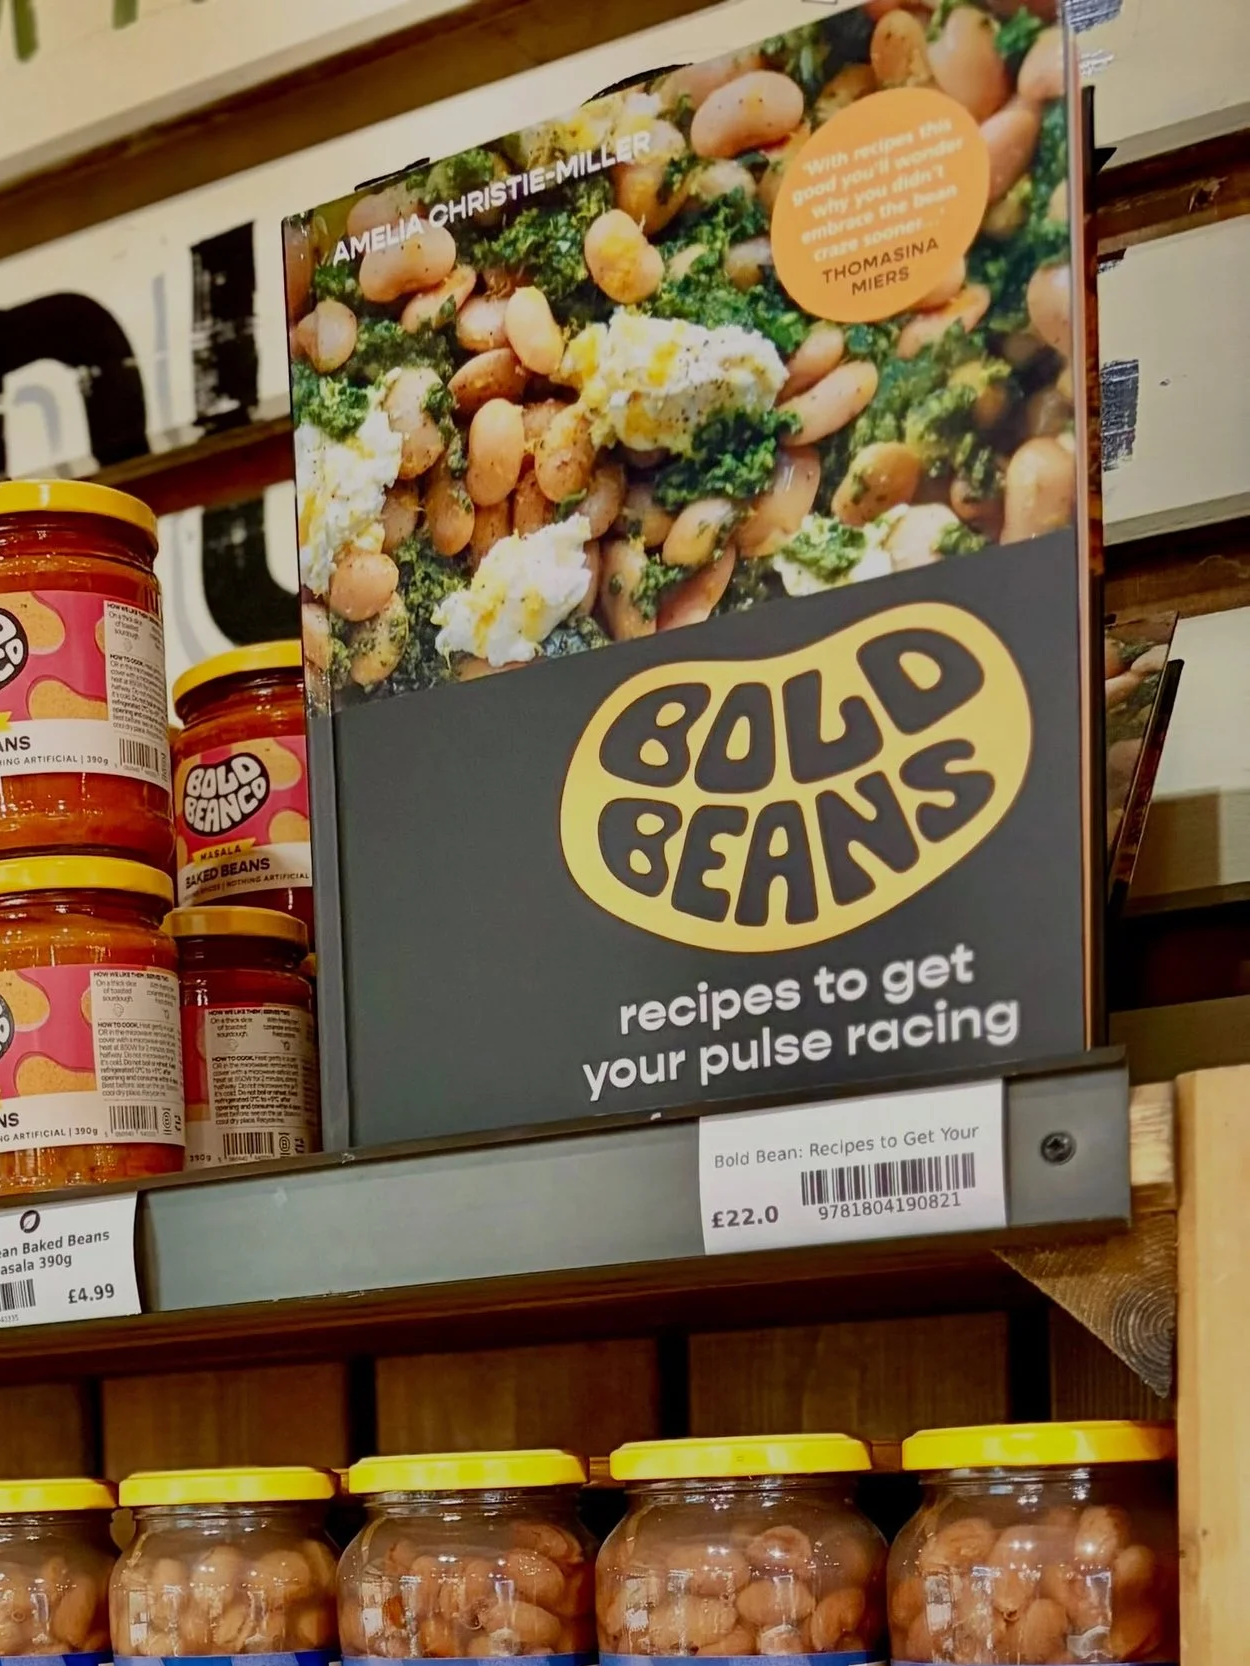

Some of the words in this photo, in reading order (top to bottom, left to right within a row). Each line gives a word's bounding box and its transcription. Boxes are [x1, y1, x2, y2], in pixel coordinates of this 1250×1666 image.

[333, 212, 426, 267] AMELIA
[428, 130, 651, 229] CHRISTIE-MILLER
[791, 178, 837, 208] good
[854, 184, 888, 211] you
[879, 198, 908, 220] the
[821, 237, 939, 284] THOMASINA
[851, 265, 910, 297] MIERS
[598, 627, 985, 794] BOLD
[23, 754, 79, 766] ARTIFICIAL
[86, 755, 110, 767] 390g
[596, 738, 996, 928] BEANS
[619, 976, 801, 1035] recipes
[814, 963, 867, 1006] to
[881, 943, 975, 1004] get
[582, 1045, 687, 1102] your
[699, 1021, 832, 1087] pulse
[847, 1000, 1021, 1057] racing
[12, 1127, 67, 1141] ARTIFICIAL
[74, 1126, 98, 1138] 390g
[714, 1151, 750, 1169] Bold
[756, 1145, 803, 1165] Bean:
[809, 1135, 875, 1157] Recipes
[880, 1134, 898, 1149] to
[903, 1129, 935, 1147] Get
[940, 1124, 980, 1143] Your
[711, 1204, 779, 1229] £22.0
[818, 1191, 962, 1221] 9781804190821
[22, 1236, 63, 1255] Baked
[67, 1230, 110, 1247] Beans
[39, 1253, 72, 1270] 390g
[67, 1283, 115, 1305] £4.99
